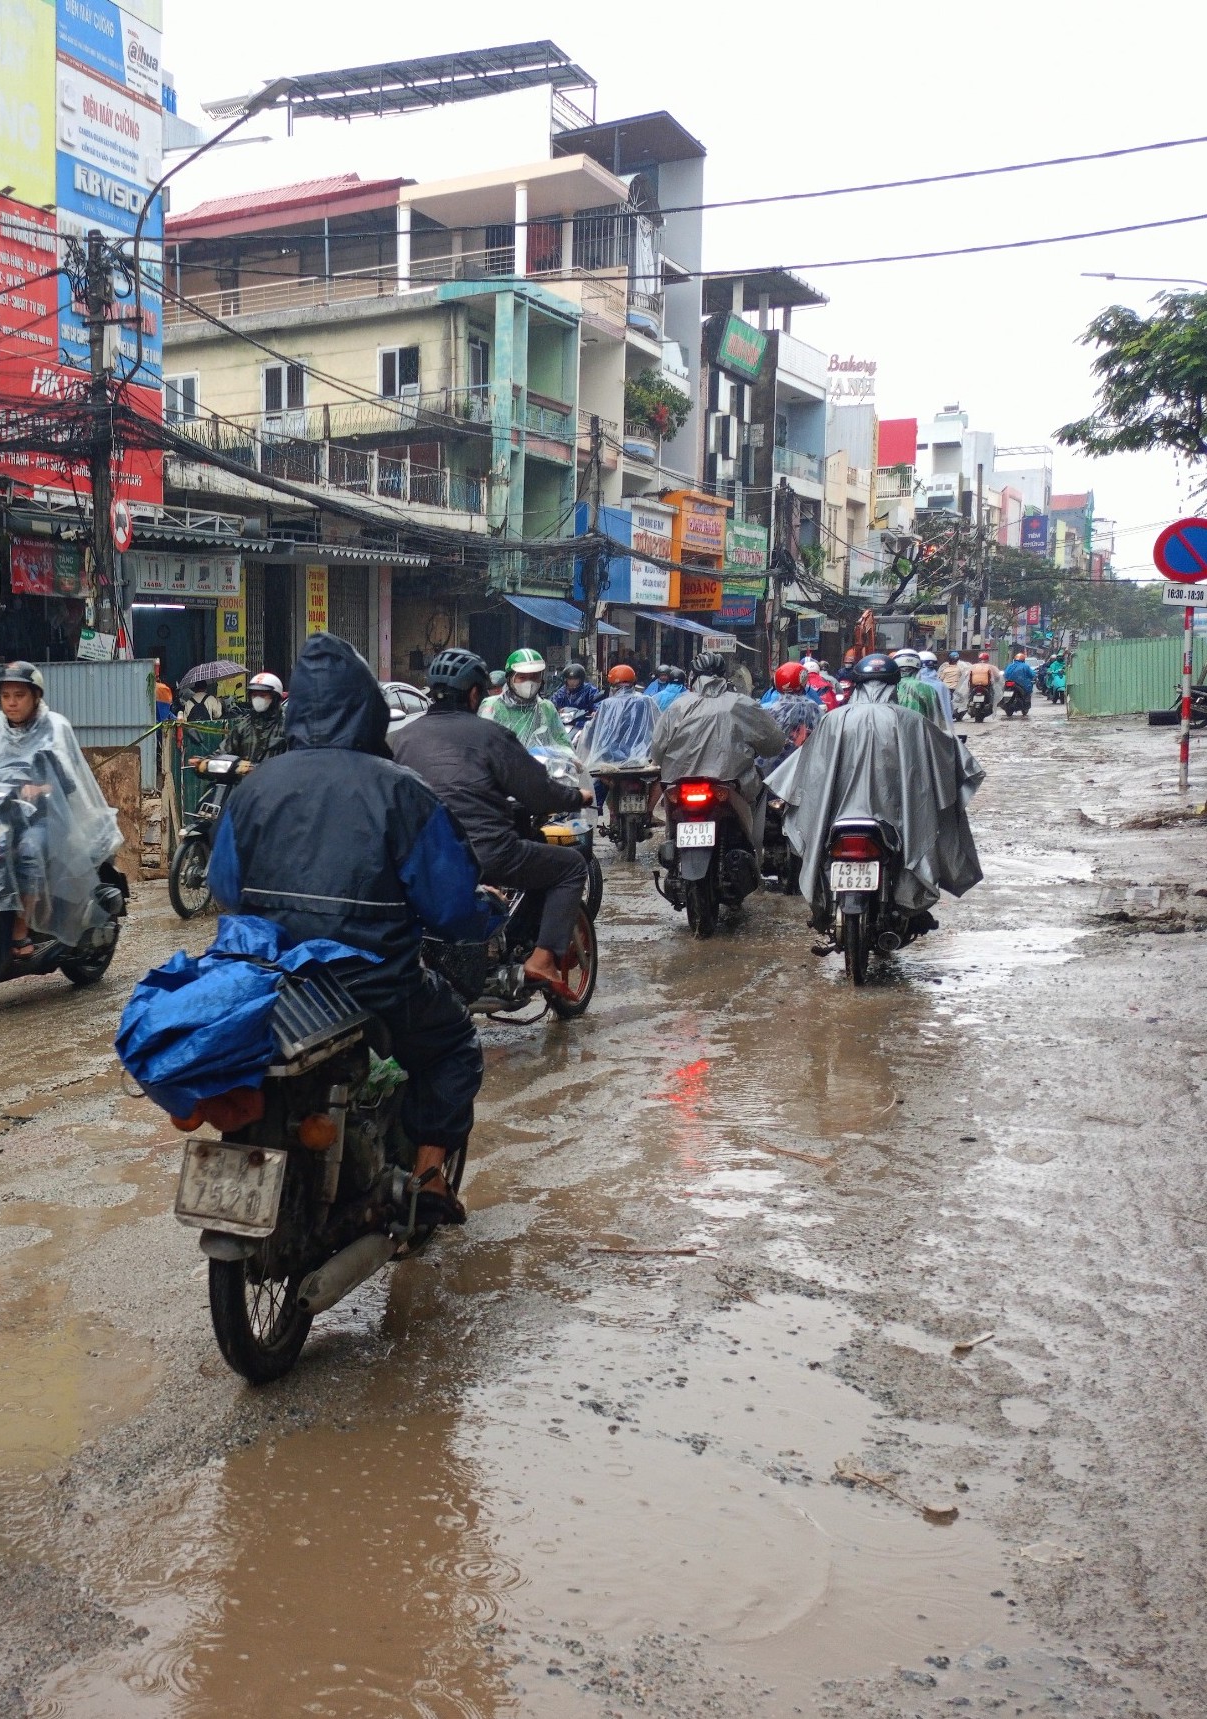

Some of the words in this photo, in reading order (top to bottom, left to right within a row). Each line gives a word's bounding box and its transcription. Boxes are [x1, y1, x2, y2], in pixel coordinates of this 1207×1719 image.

[83, 94, 99, 124] ĐIỆN
[99, 101, 114, 129] MÁY
[114, 108, 140, 142] CƯỜNG
[11, 295, 29, 312] SMART
[827, 353, 877, 375] Bakery
[1167, 588, 1184, 600] 16:30
[1187, 590, 1205, 601] 18:30
[225, 613, 238, 626] 75
[679, 834, 714, 847] 621.33
[837, 875, 872, 889] 4623
